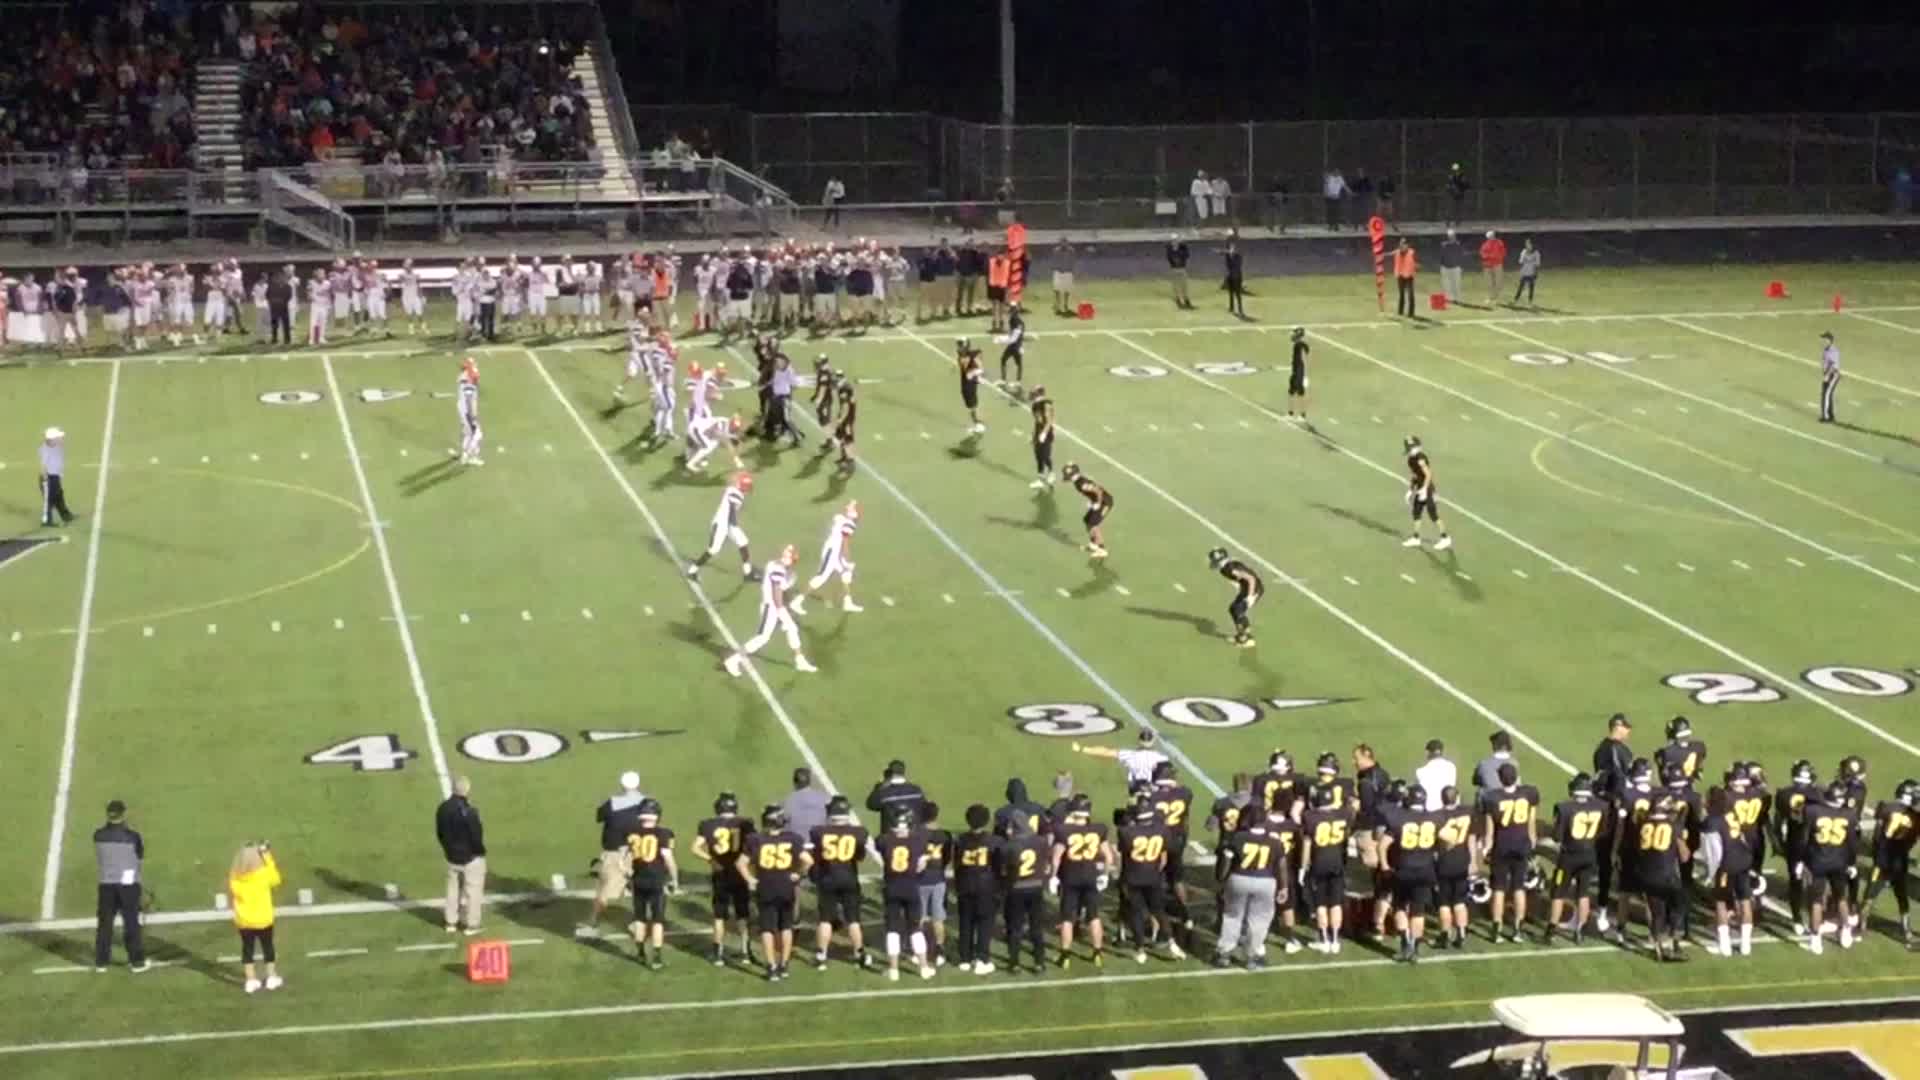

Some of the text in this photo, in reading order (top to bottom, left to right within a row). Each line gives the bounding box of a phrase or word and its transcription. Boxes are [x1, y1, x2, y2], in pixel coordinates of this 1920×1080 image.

[1660, 665, 1914, 705] 20
[1007, 697, 1264, 736] 30
[304, 729, 571, 771] 40
[1500, 799, 1528, 826] 78
[1572, 812, 1601, 839] 67
[1816, 816, 1848, 844] 35
[627, 833, 658, 862] 30
[759, 843, 792, 869] 65
[822, 834, 856, 861] 50
[891, 846, 909, 872] 8
[1067, 832, 1100, 861] 23
[1131, 835, 1164, 862] 20
[1241, 843, 1270, 869] 71
[1019, 849, 1036, 876] 2
[474, 948, 503, 975] 40
